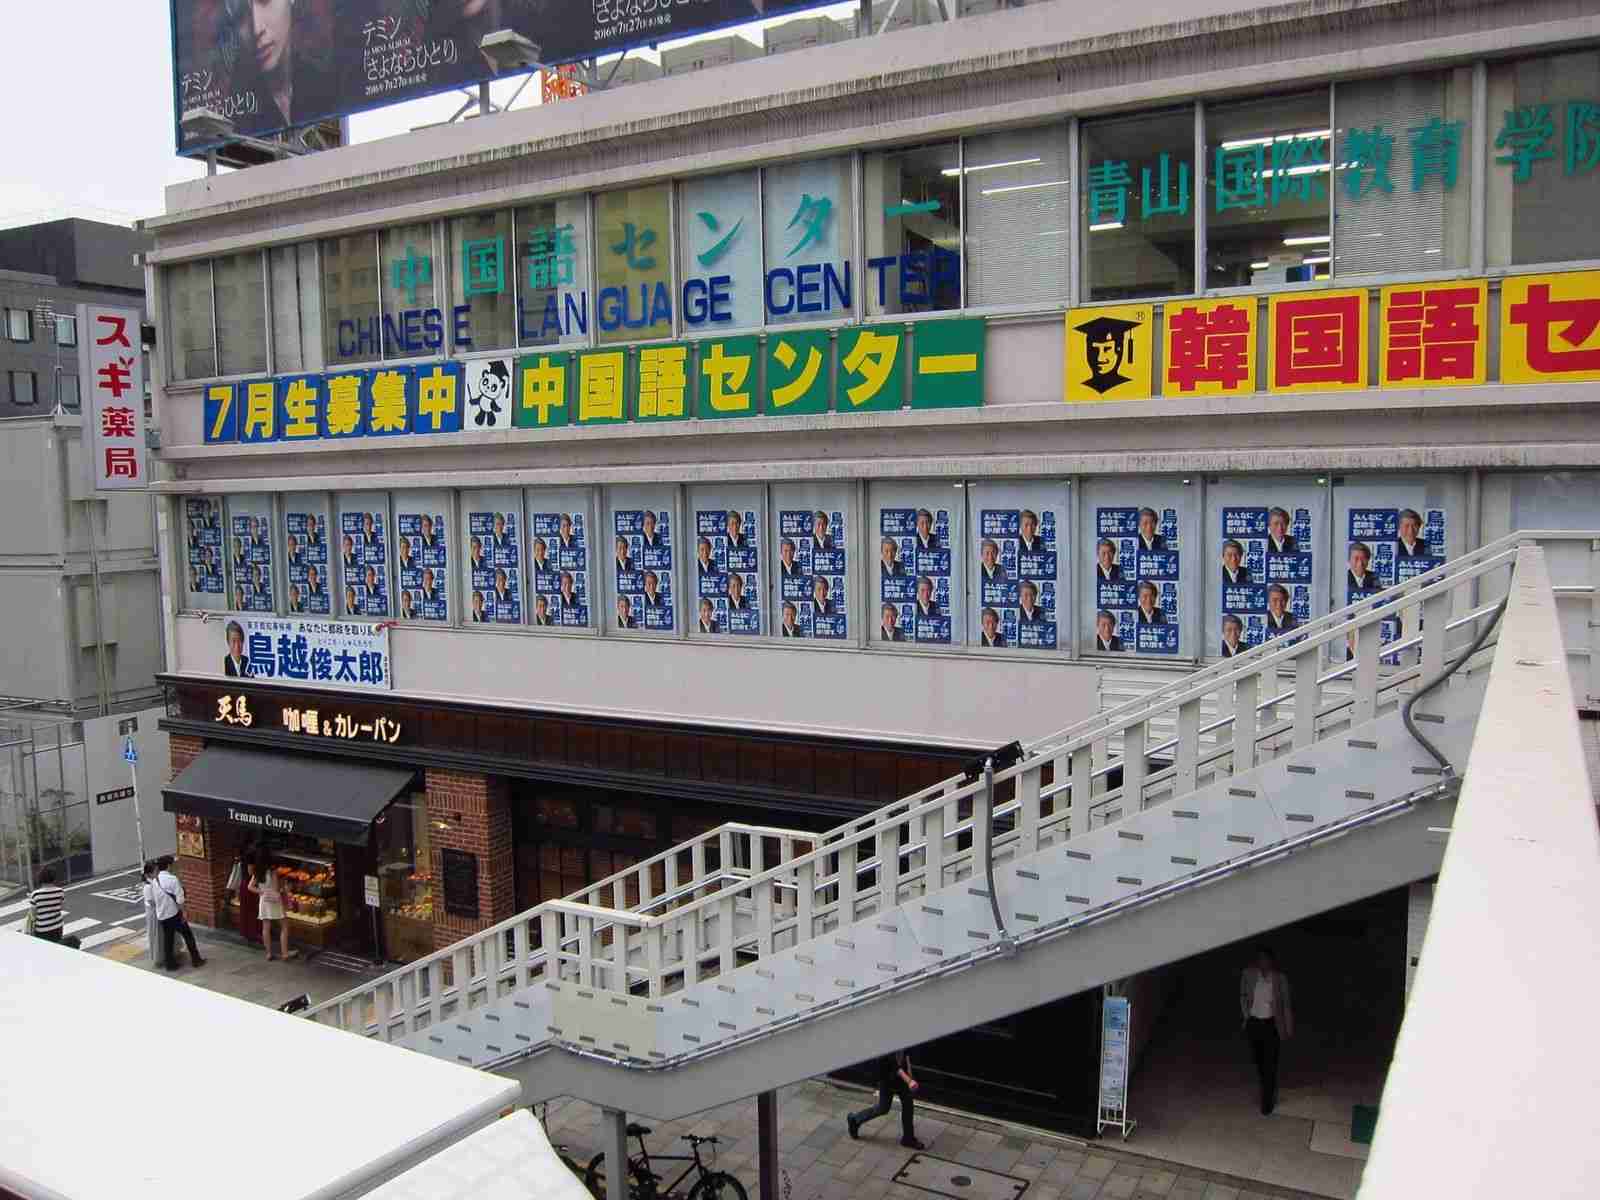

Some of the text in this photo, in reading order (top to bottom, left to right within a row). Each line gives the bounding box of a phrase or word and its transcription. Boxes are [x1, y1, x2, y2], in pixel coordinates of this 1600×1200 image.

[362, 16, 401, 46] テミン
[182, 68, 213, 93] テミン
[391, 193, 942, 305] 中国語センター
[337, 247, 963, 357] CHINESE LANGUAGE CENTER
[1168, 284, 1600, 391] 韓国語セ
[96, 315, 138, 479] スギ薬局
[208, 367, 457, 439] 7月生募集中
[522, 331, 977, 424] 中国語センター
[248, 632, 384, 685] 鳥越俊太郎
[228, 807, 295, 833] Temma Curry
